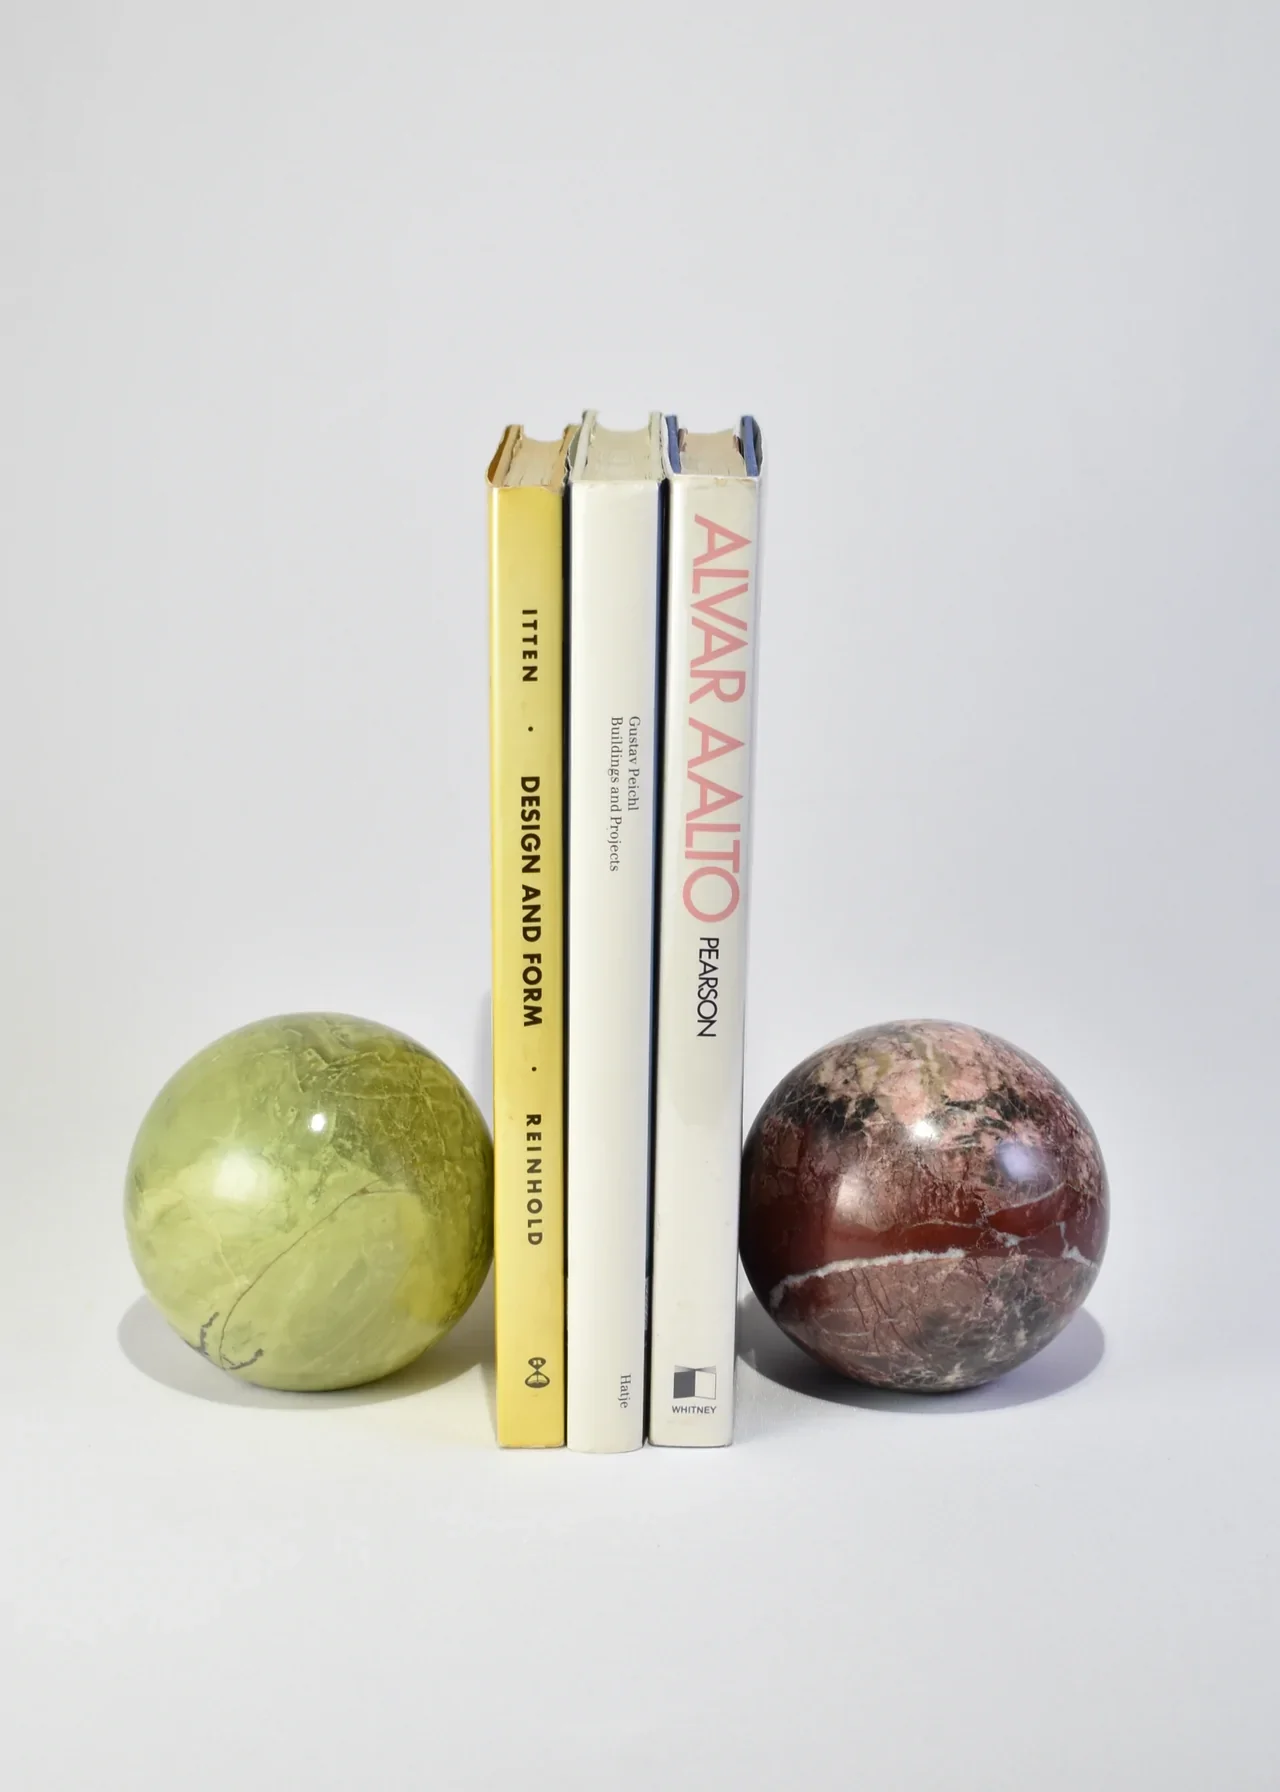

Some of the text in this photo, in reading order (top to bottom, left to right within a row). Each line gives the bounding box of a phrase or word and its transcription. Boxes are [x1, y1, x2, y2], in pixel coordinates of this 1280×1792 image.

[521, 609, 538, 682] ITTEN
[627, 716, 641, 811] Gustav Peichl
[683, 515, 752, 923] ALVAR AALTO
[607, 717, 624, 872] Buildings and Projects
[520, 776, 543, 1027] DESIGN AND FORM
[696, 936, 720, 1038] PEARSON
[526, 1113, 543, 1246] REINHOLD
[617, 1374, 632, 1409] Hatje
[671, 1405, 717, 1414] WHITNEY
